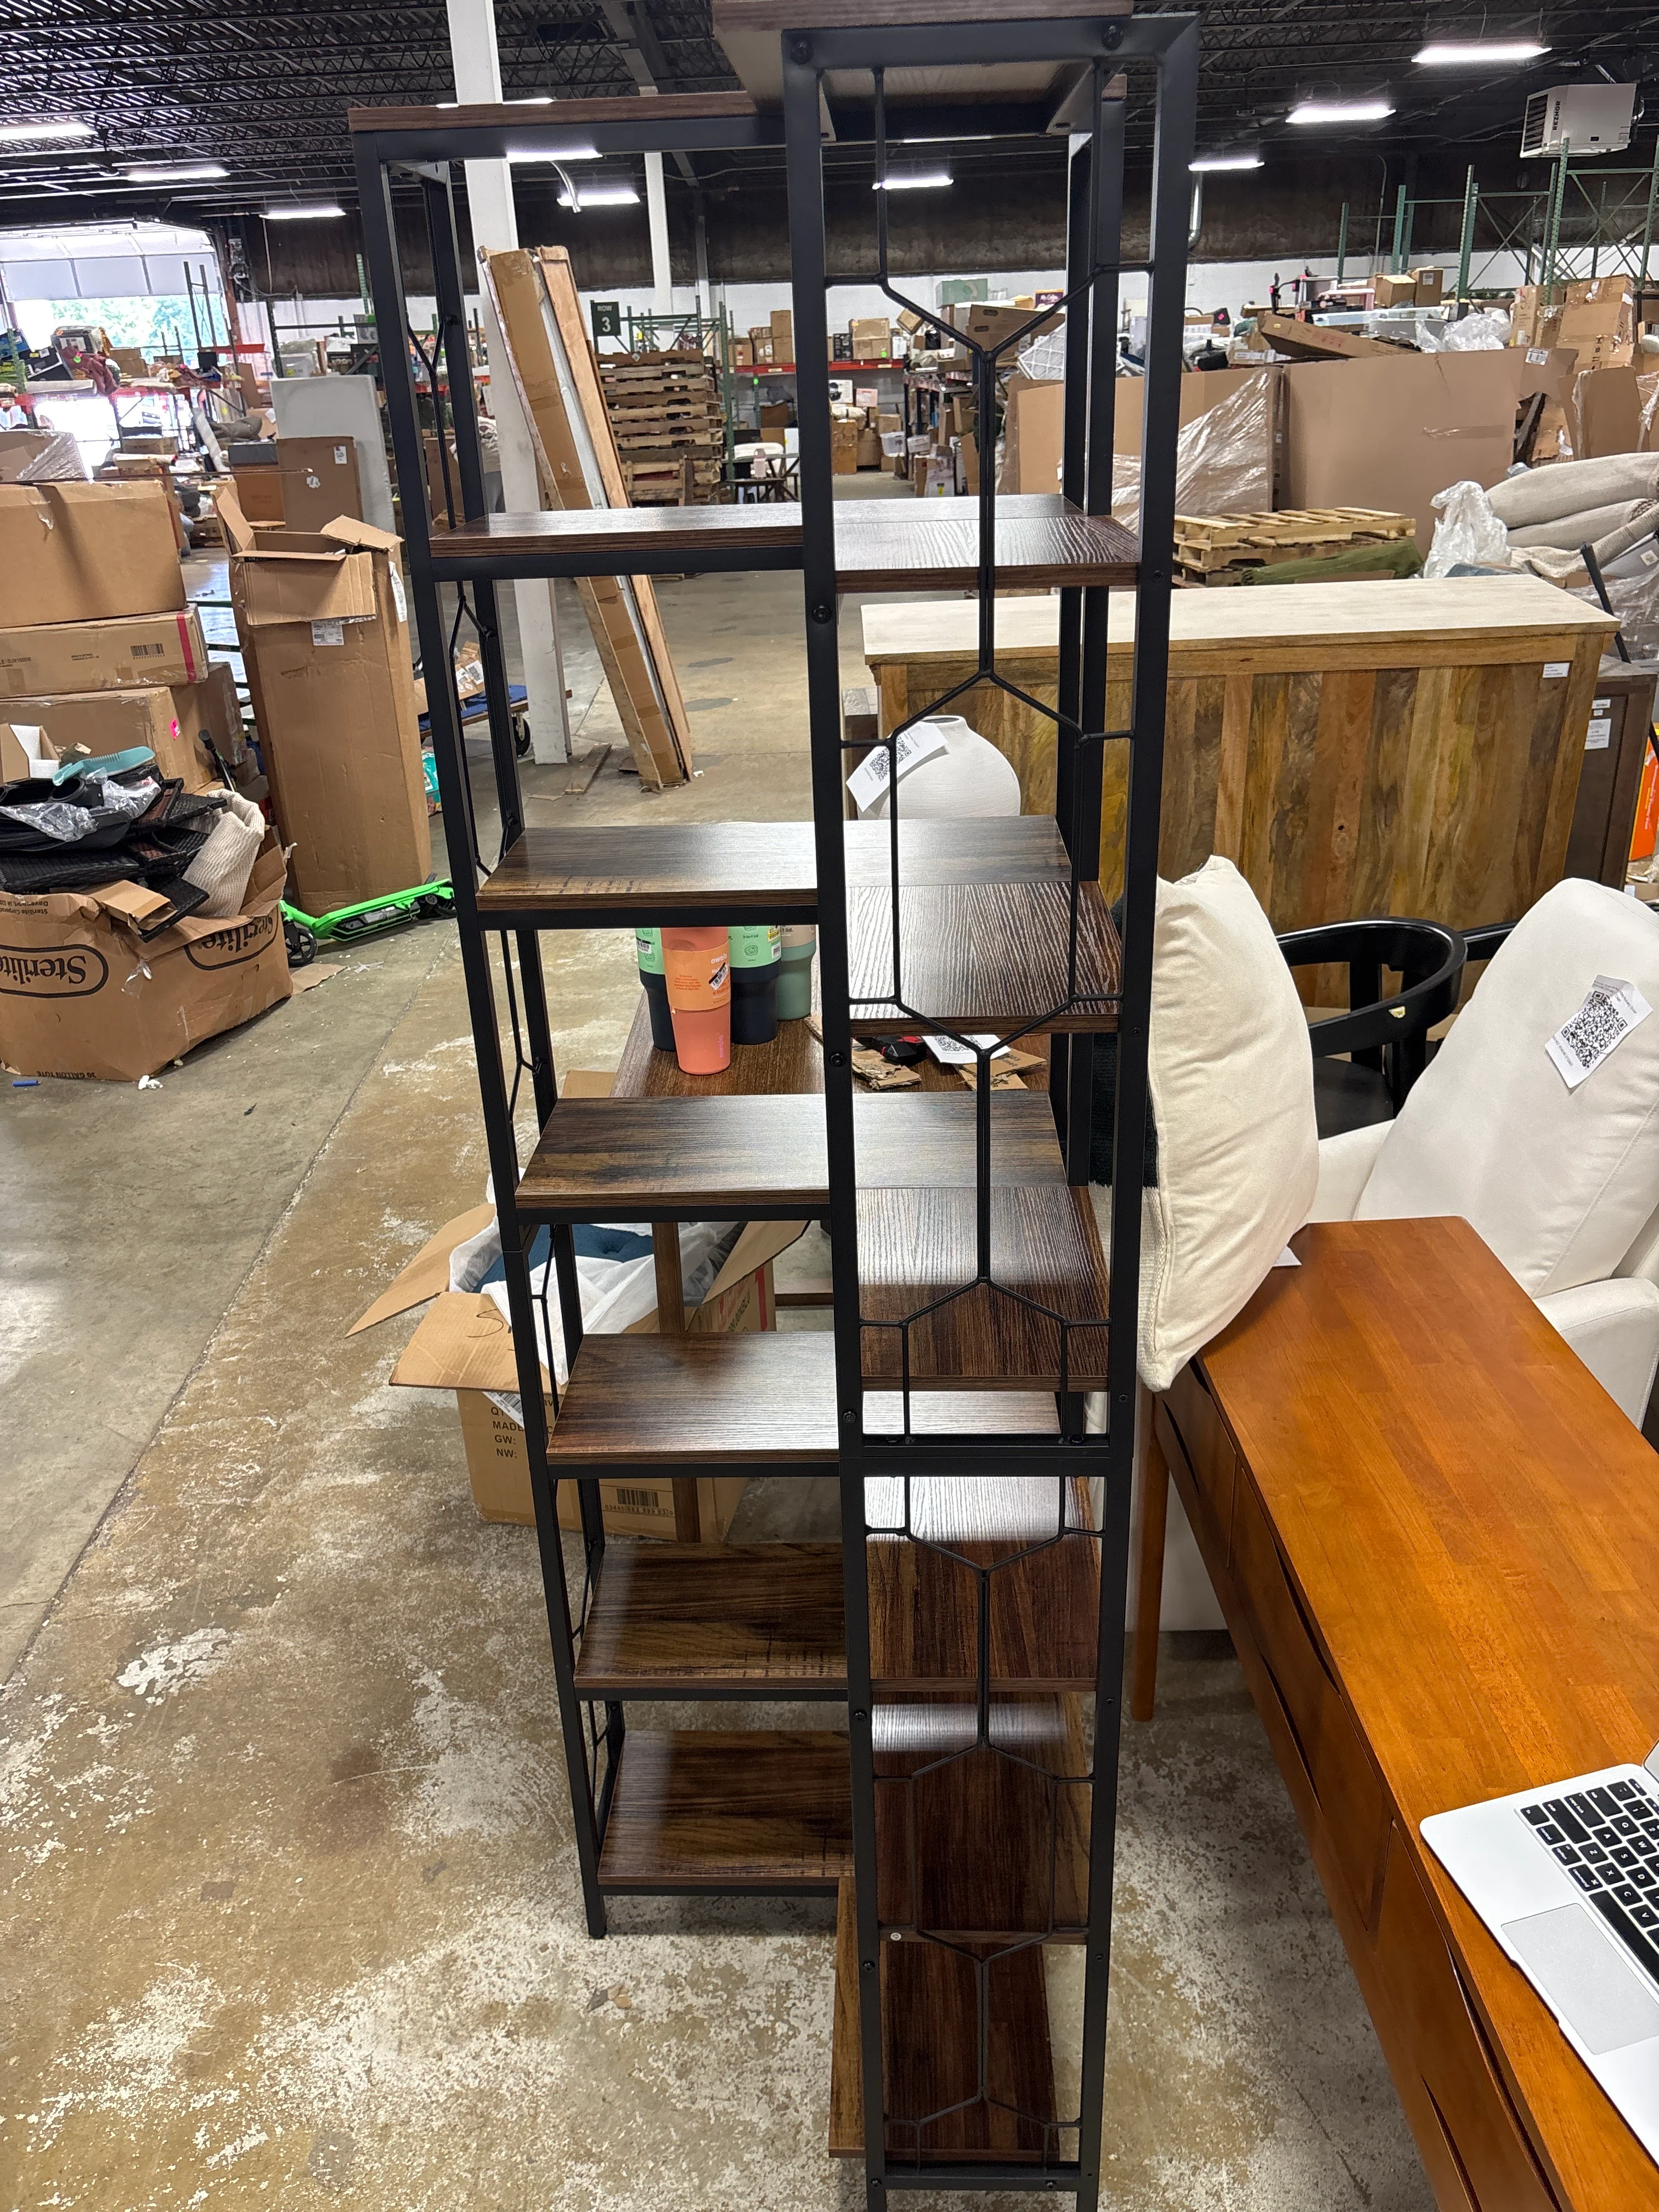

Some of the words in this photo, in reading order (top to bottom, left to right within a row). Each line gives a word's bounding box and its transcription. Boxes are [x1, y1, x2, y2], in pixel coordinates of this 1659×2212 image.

[1553, 100, 1561, 131] REZNOR
[601, 317, 611, 332] 3
[494, 1434, 516, 1445] GW:
[496, 1447, 518, 1459] NW:
